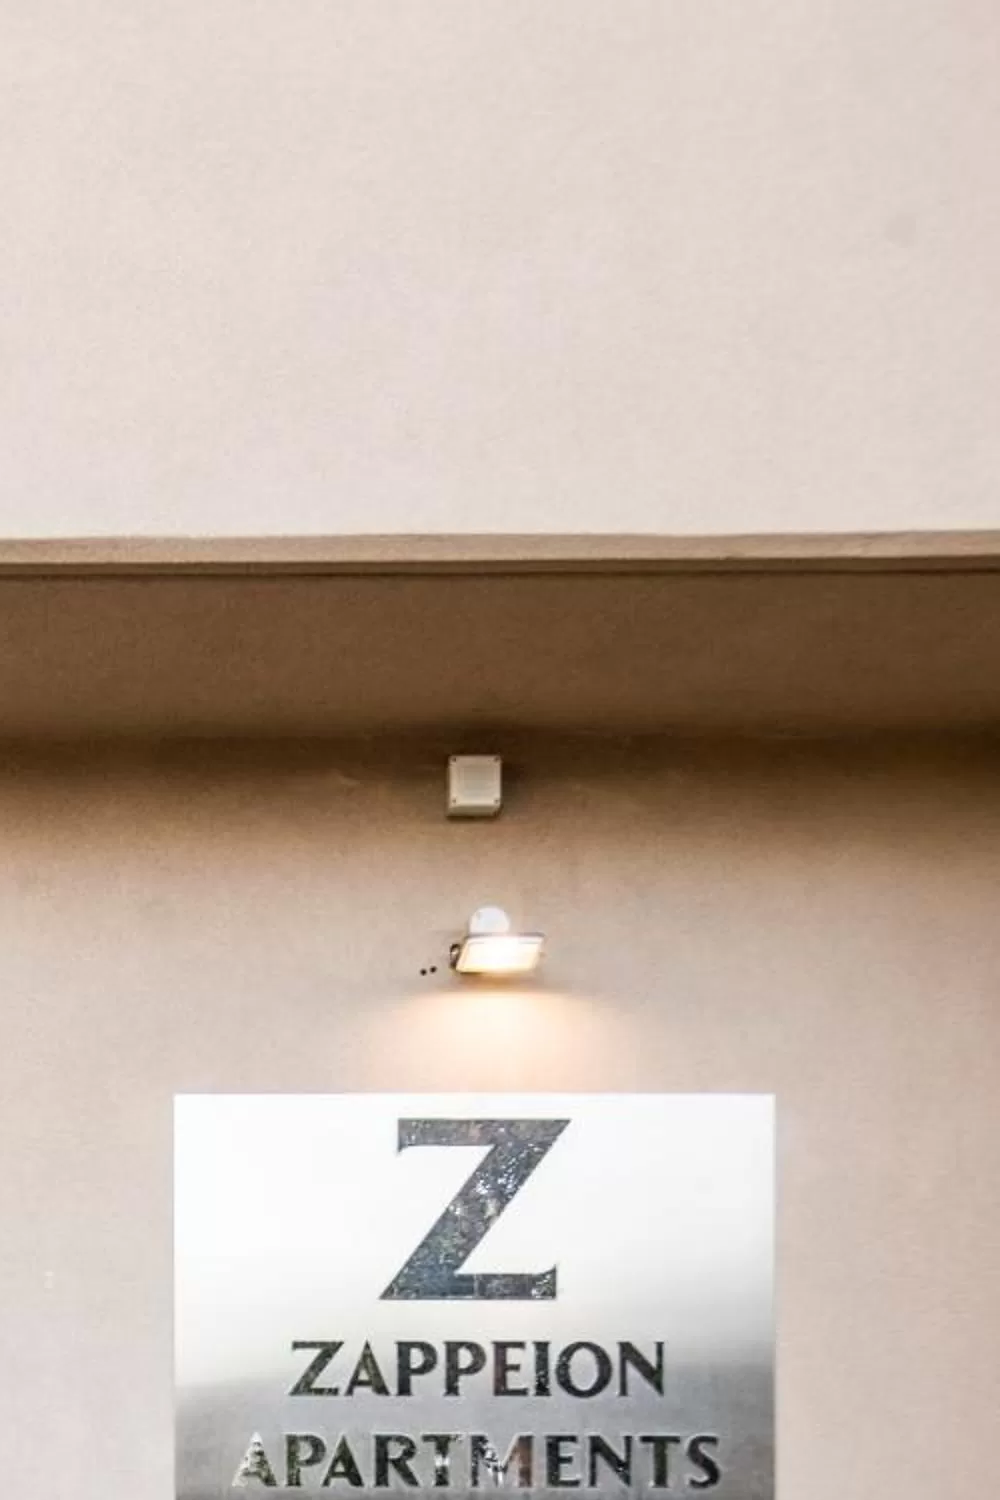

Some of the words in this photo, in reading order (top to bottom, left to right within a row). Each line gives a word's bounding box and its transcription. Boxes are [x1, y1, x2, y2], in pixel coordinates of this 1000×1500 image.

[378, 1117, 572, 1300] Z
[288, 1340, 665, 1397] ZAPPEION
[231, 1431, 722, 1490] APARTMENTS
